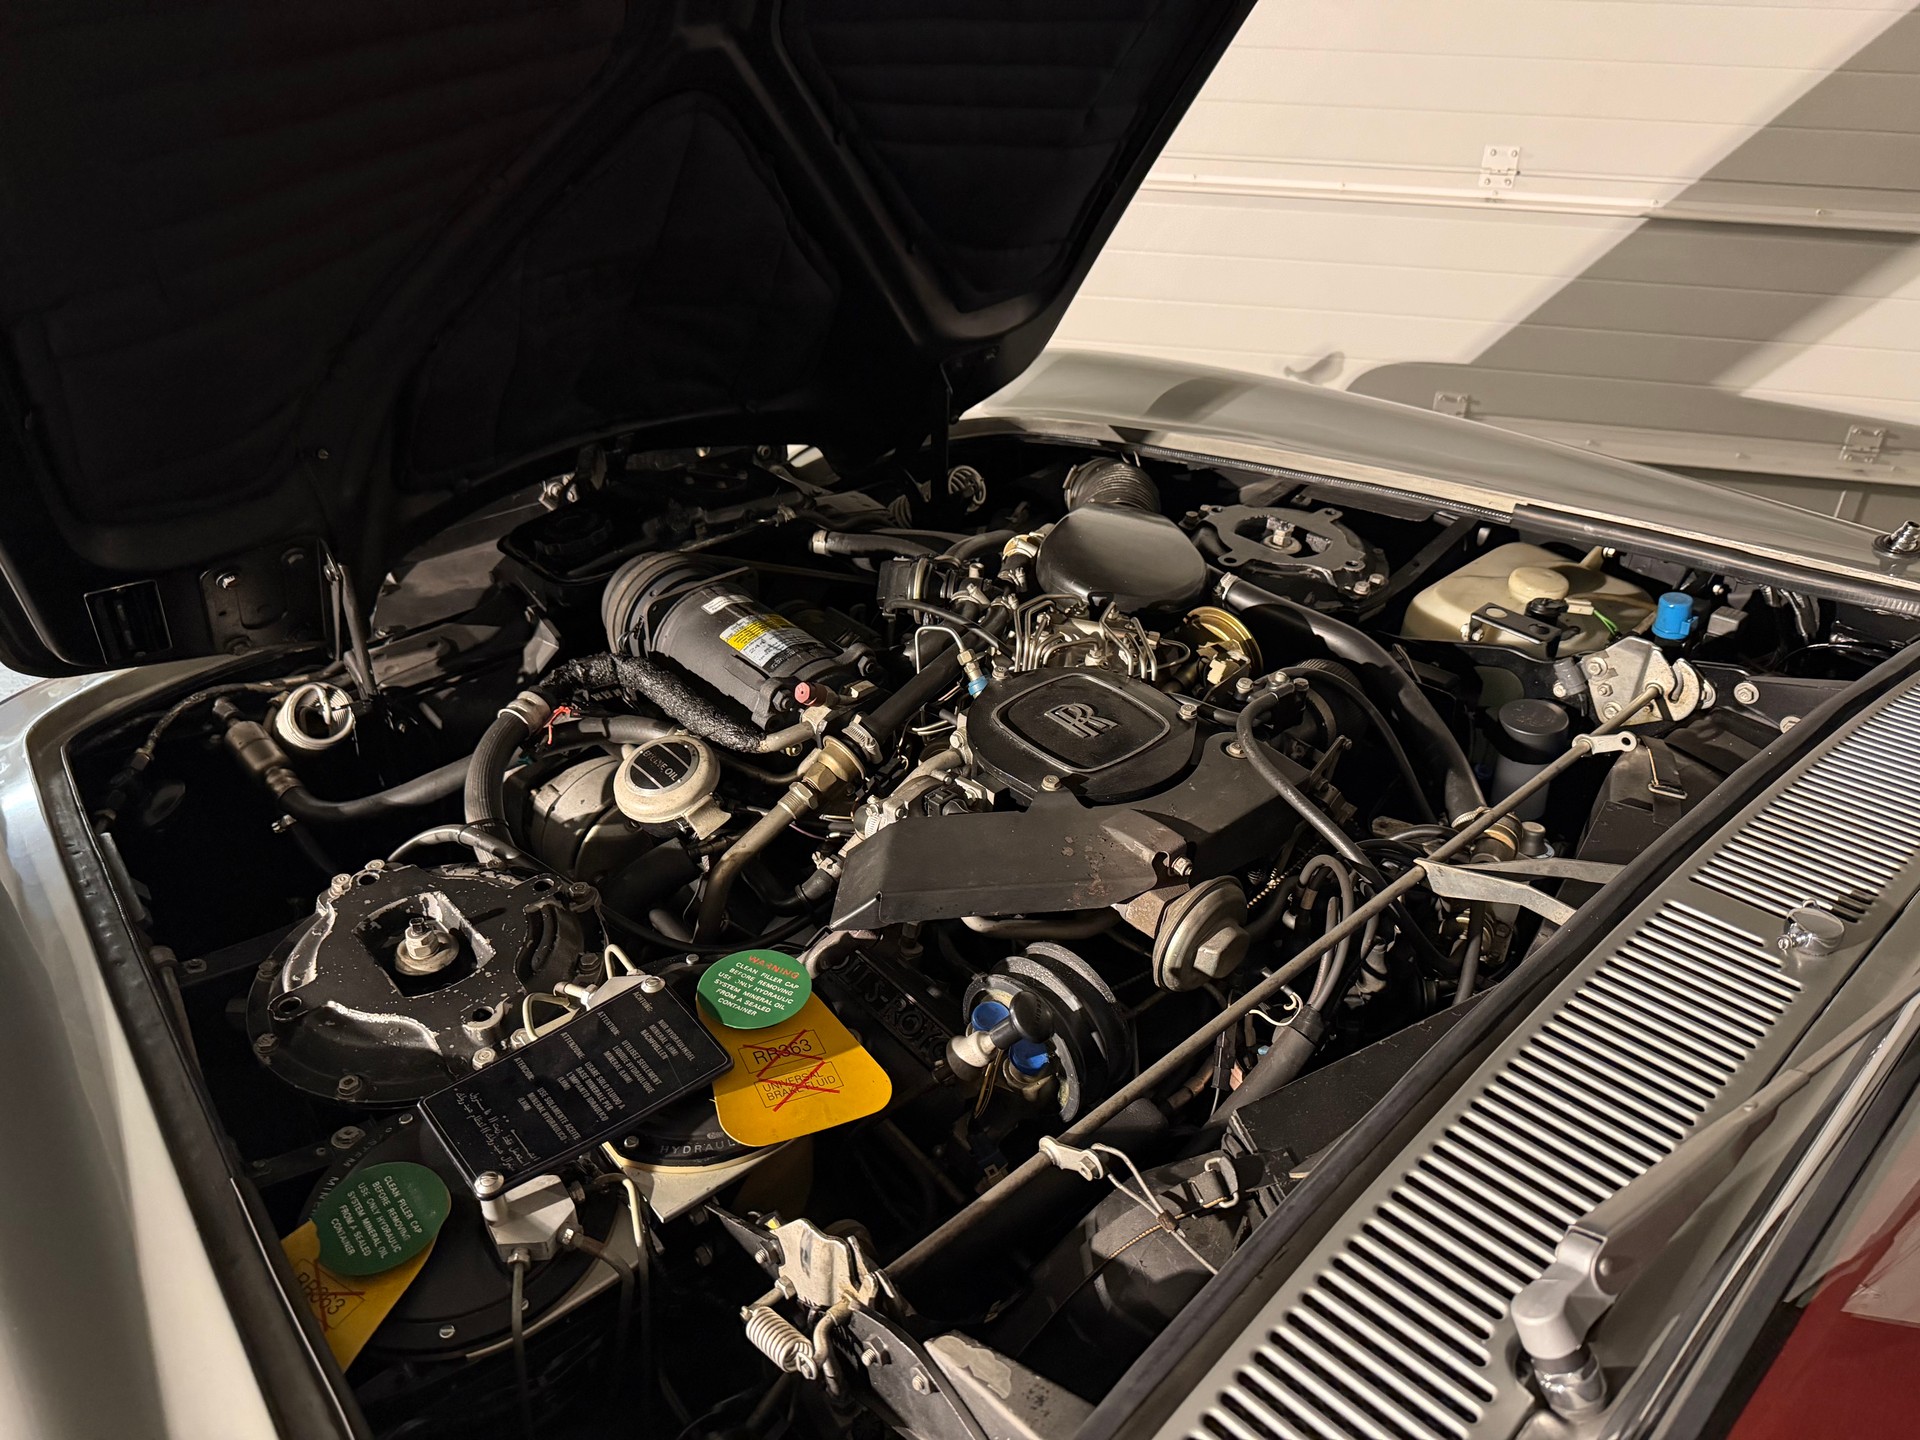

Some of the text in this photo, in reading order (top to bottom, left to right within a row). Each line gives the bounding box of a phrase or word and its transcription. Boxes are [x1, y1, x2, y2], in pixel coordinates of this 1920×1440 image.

[664, 768, 679, 782] OIL
[718, 972, 732, 980] USE
[754, 986, 794, 1004] HYDRAULIC
[729, 968, 794, 996] BEFORE REMOVING
[736, 962, 800, 989] CLEAN FILLER CAP
[714, 978, 785, 1010] SYSTEM MINERAL OIL
[716, 988, 736, 1000] FROM
[744, 1000, 772, 1012] SEALED
[718, 998, 758, 1016] CONTAINER
[649, 1024, 668, 1044] MINERAL
[604, 1051, 622, 1071] MINERAL
[622, 1040, 662, 1085] UTILISEZ SEULEMENT
[752, 1038, 812, 1064] RR363
[576, 1067, 589, 1080] BASE
[602, 1100, 613, 1111] PER
[585, 1061, 600, 1077] USARE
[596, 1076, 610, 1089] SOLO
[762, 1070, 824, 1092] UNIVERSAL
[766, 1075, 836, 1101] BRAKE FLUID
[537, 1087, 581, 1140] USE SOLAMENTE ACEITE
[358, 1182, 402, 1253] USE ONLY HYDRAULIC
[372, 1181, 411, 1241] BEFORE REMOVING
[384, 1176, 402, 1198] CLEAN
[398, 1198, 414, 1220] FILLER
[410, 1220, 422, 1234] CAP
[331, 1218, 356, 1256] CONTAINER
[340, 1204, 354, 1225] FROM
[354, 1230, 372, 1256] SEALED
[347, 1190, 388, 1259] SYSTEM MINERAL OIL
